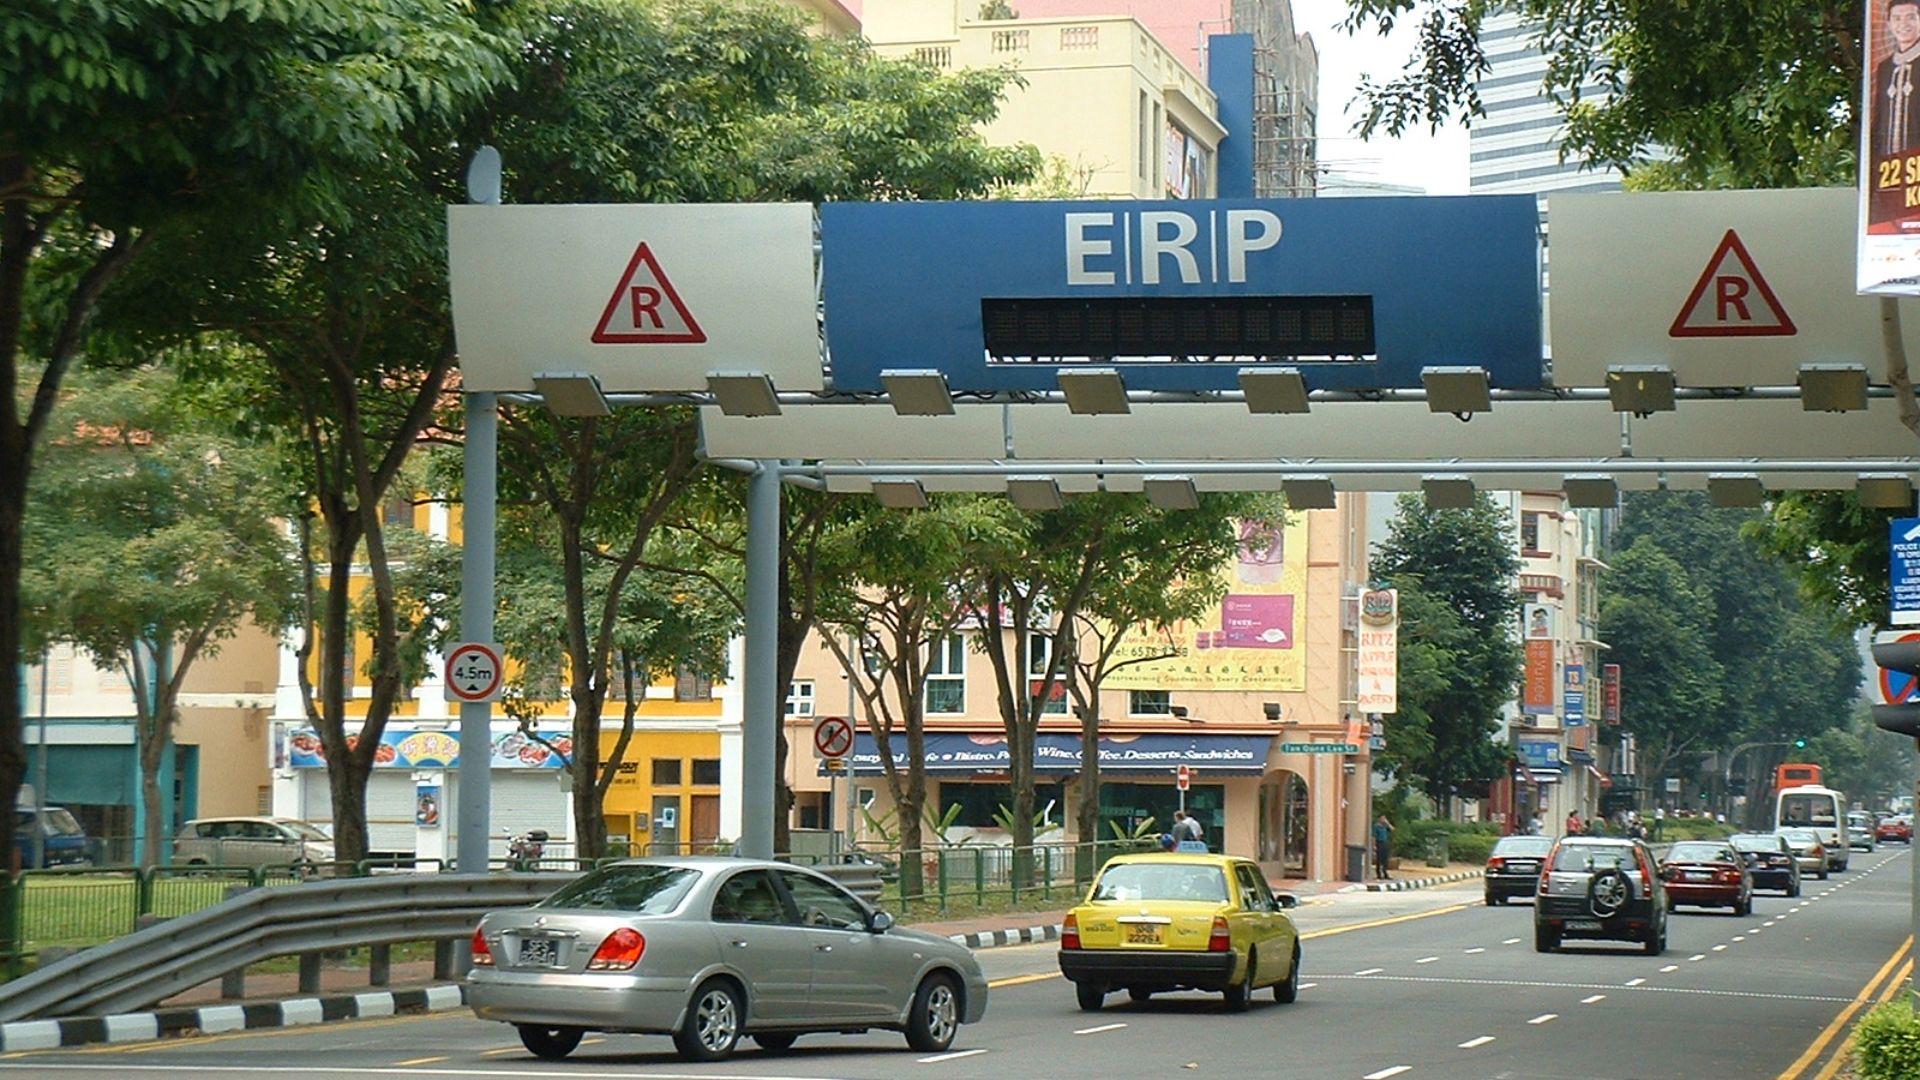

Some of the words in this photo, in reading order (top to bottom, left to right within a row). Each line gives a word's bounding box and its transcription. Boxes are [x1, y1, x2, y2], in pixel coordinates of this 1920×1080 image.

[1879, 159, 1901, 188] 22
[631, 286, 664, 329] R
[1716, 276, 1752, 320] R
[455, 666, 492, 680] 4.5m
